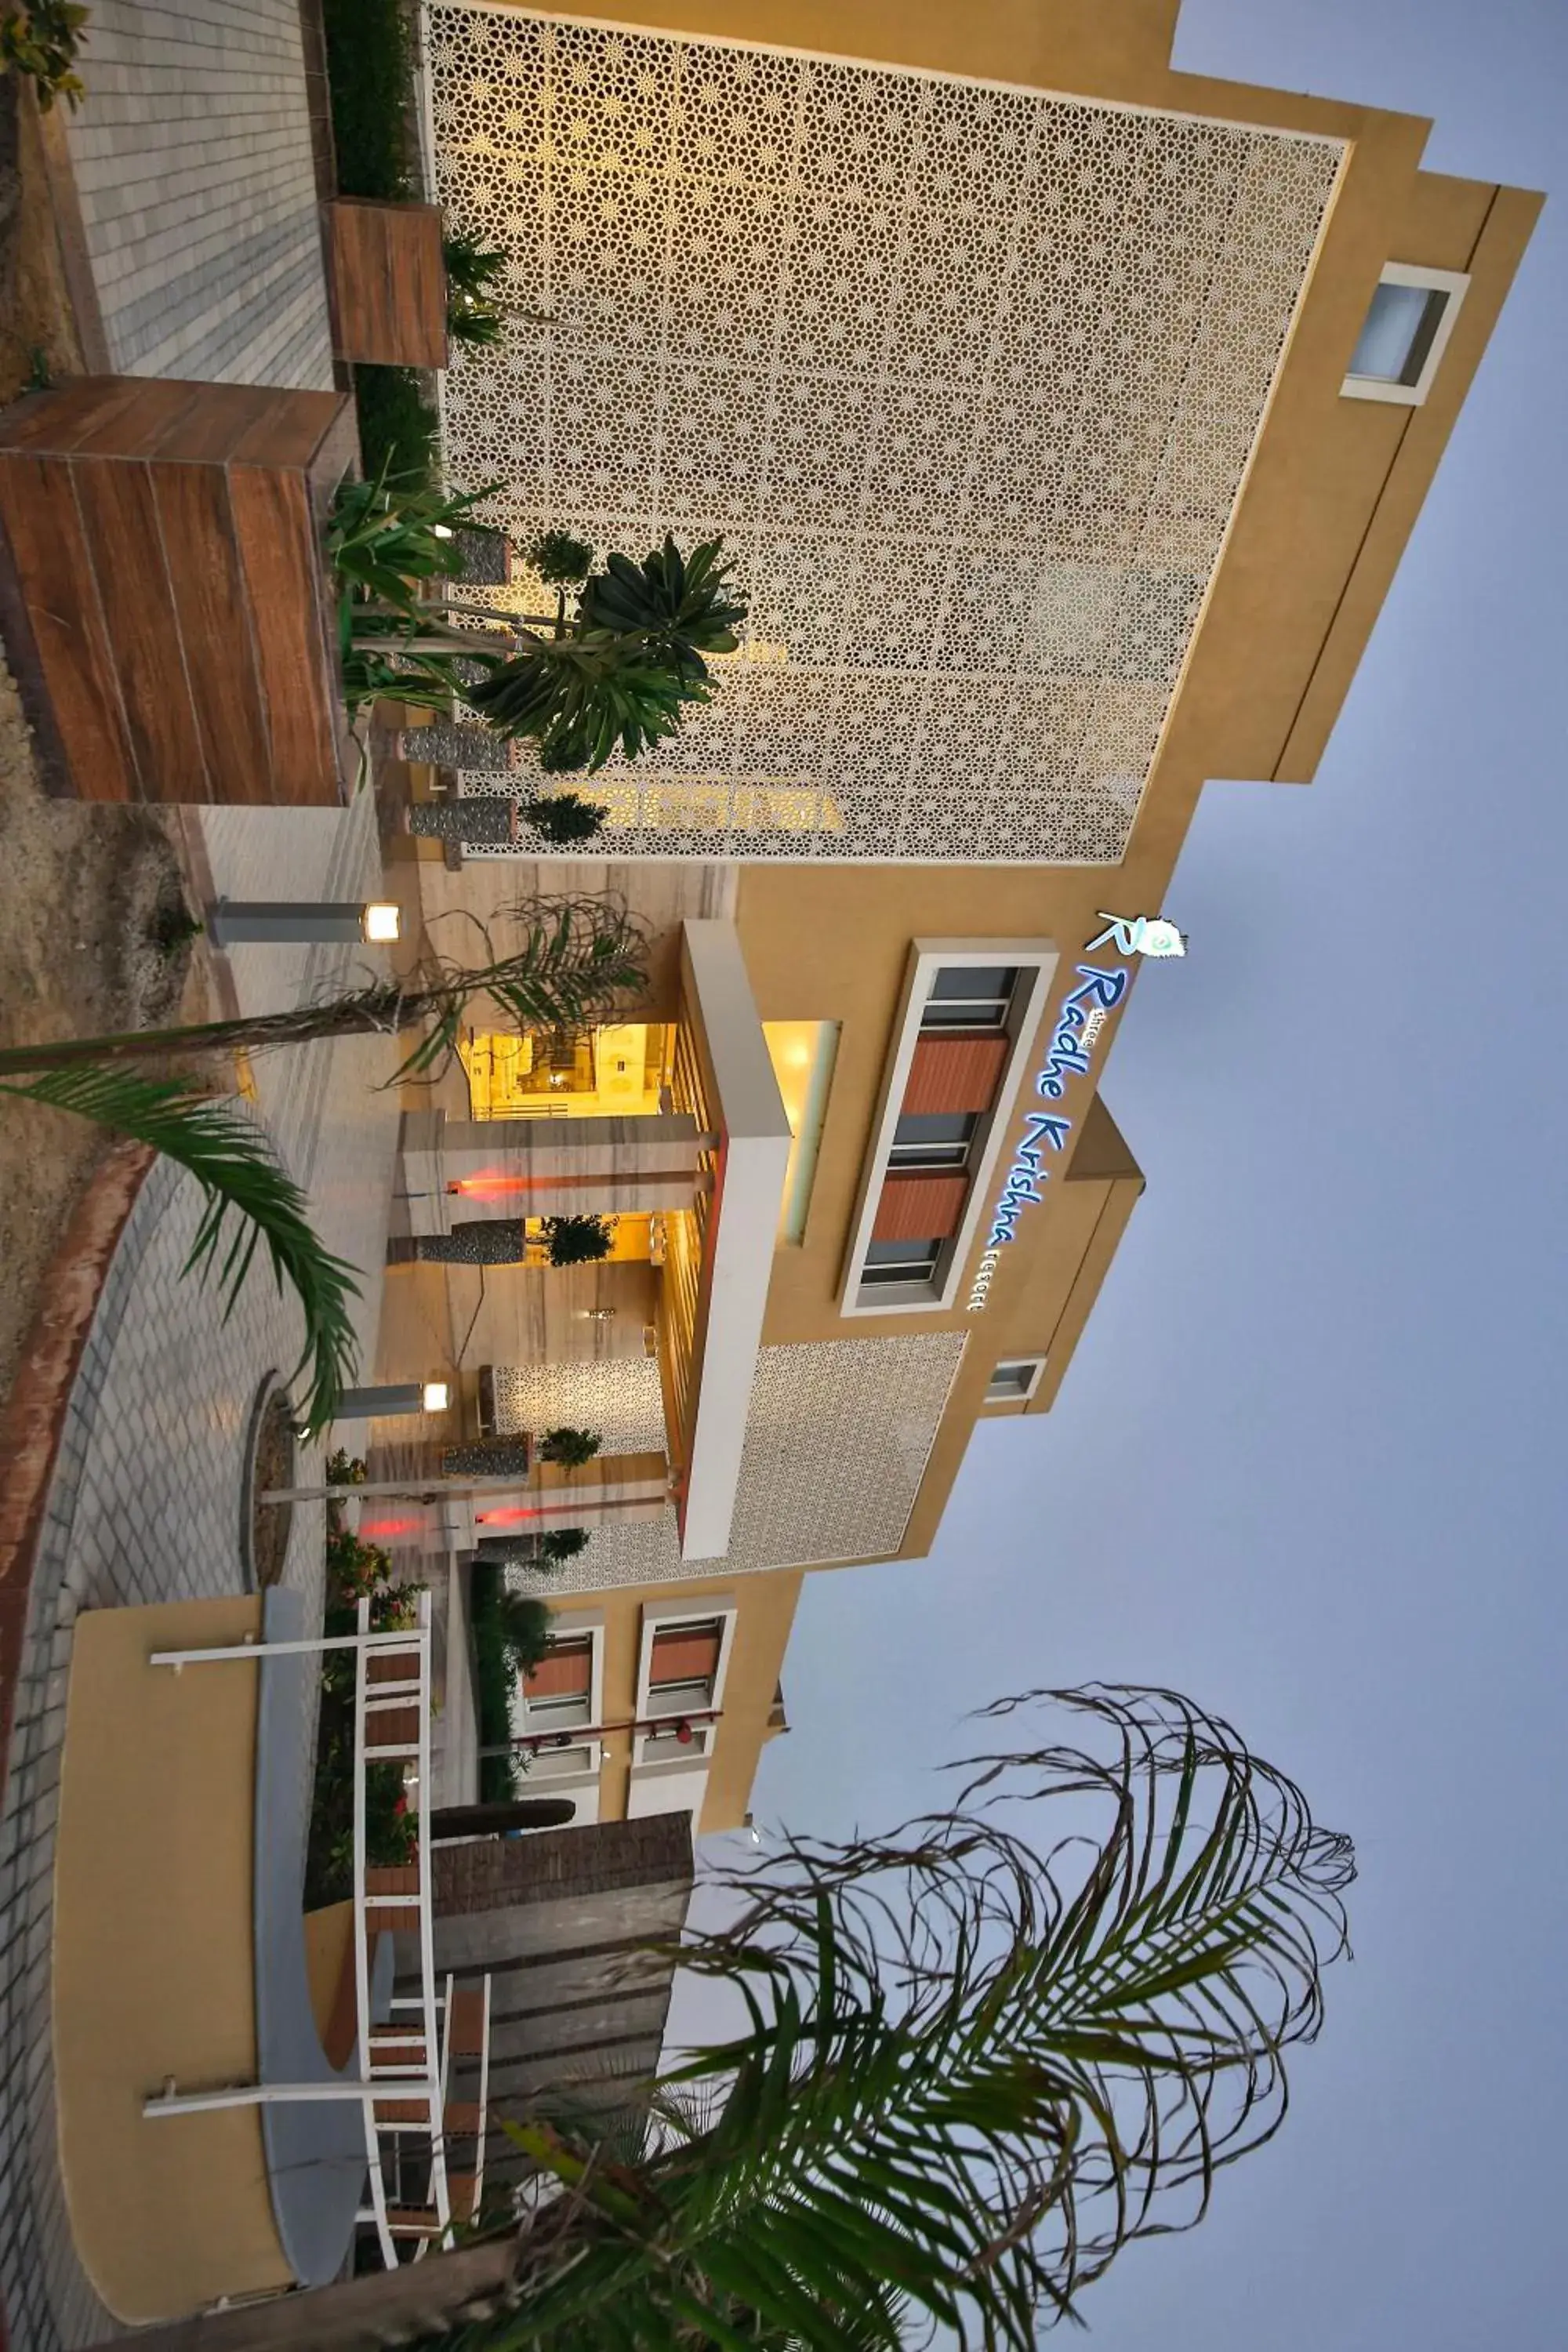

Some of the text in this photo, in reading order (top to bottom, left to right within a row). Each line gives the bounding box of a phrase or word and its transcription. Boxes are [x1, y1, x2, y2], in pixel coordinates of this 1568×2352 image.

[1083, 1010, 1106, 1048] shree
[967, 966, 1129, 1311] Radhe Krishna resort
